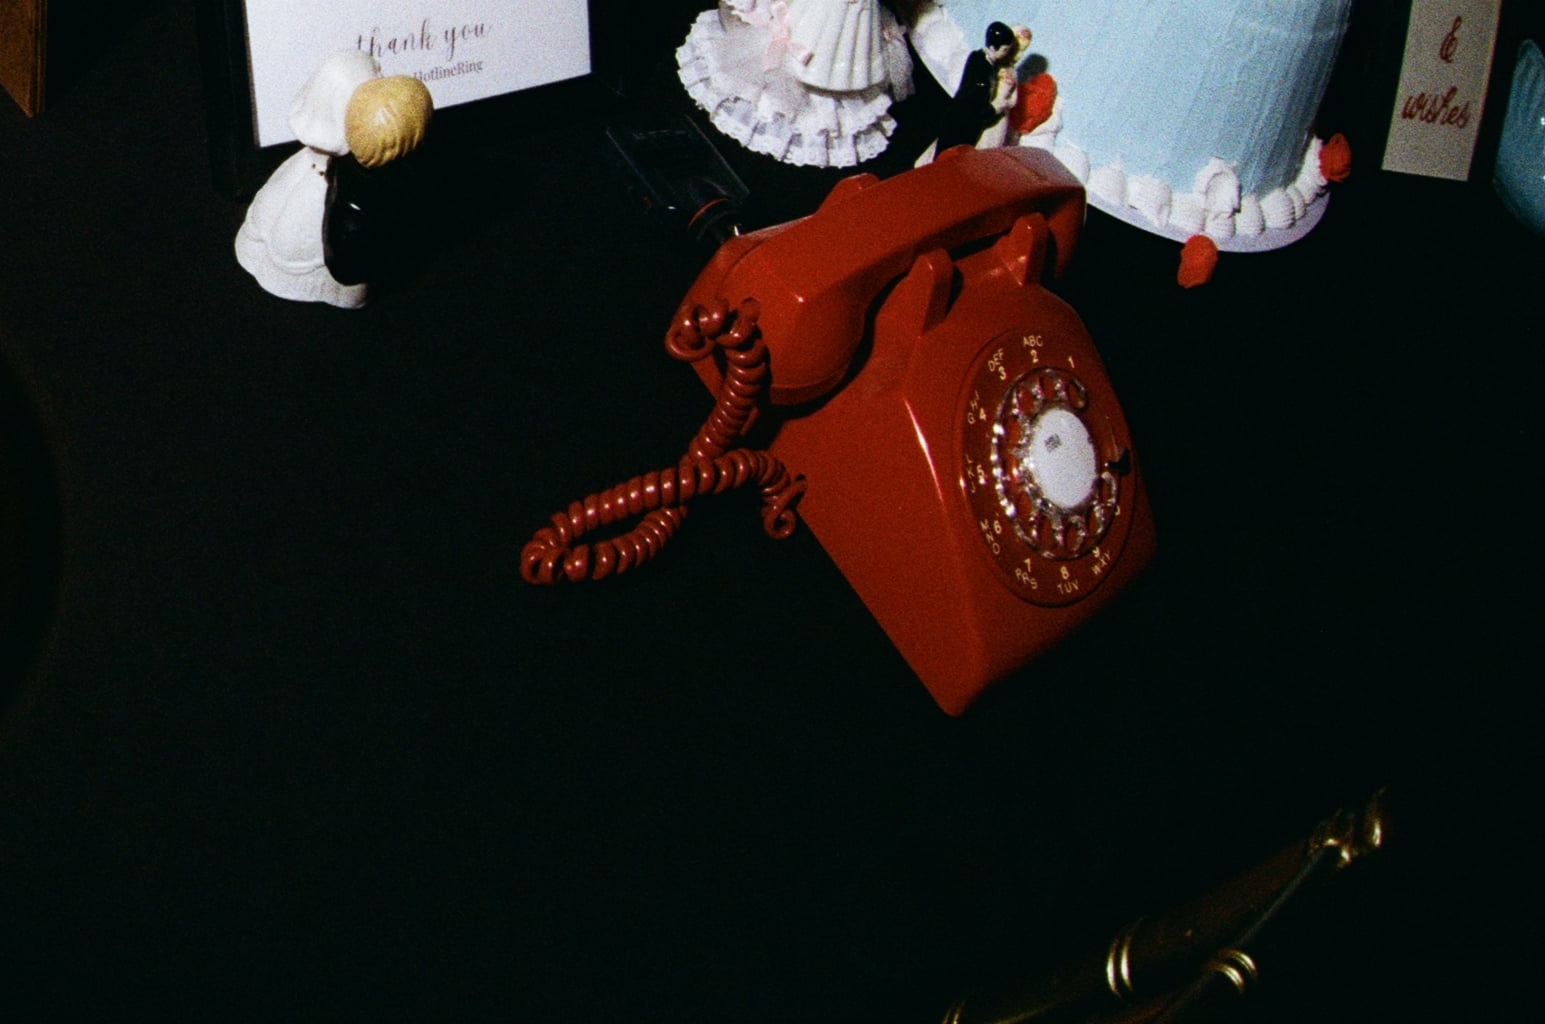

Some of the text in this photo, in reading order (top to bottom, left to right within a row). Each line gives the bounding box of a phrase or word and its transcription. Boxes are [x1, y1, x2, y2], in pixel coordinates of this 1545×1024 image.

[356, 18, 492, 63] thank you
[1401, 86, 1472, 128] wishes
[1022, 335, 1043, 348] ABC
[988, 349, 1005, 372] DEF
[1030, 350, 1039, 363] 2
[1068, 356, 1075, 369] 1
[999, 366, 1006, 380] 3
[979, 408, 987, 421] 4
[993, 521, 1002, 534] 6
[1024, 558, 1033, 572] 7
[1015, 569, 1038, 590] PRS
[1060, 566, 1069, 579] 8
[1057, 579, 1079, 594] TUV
